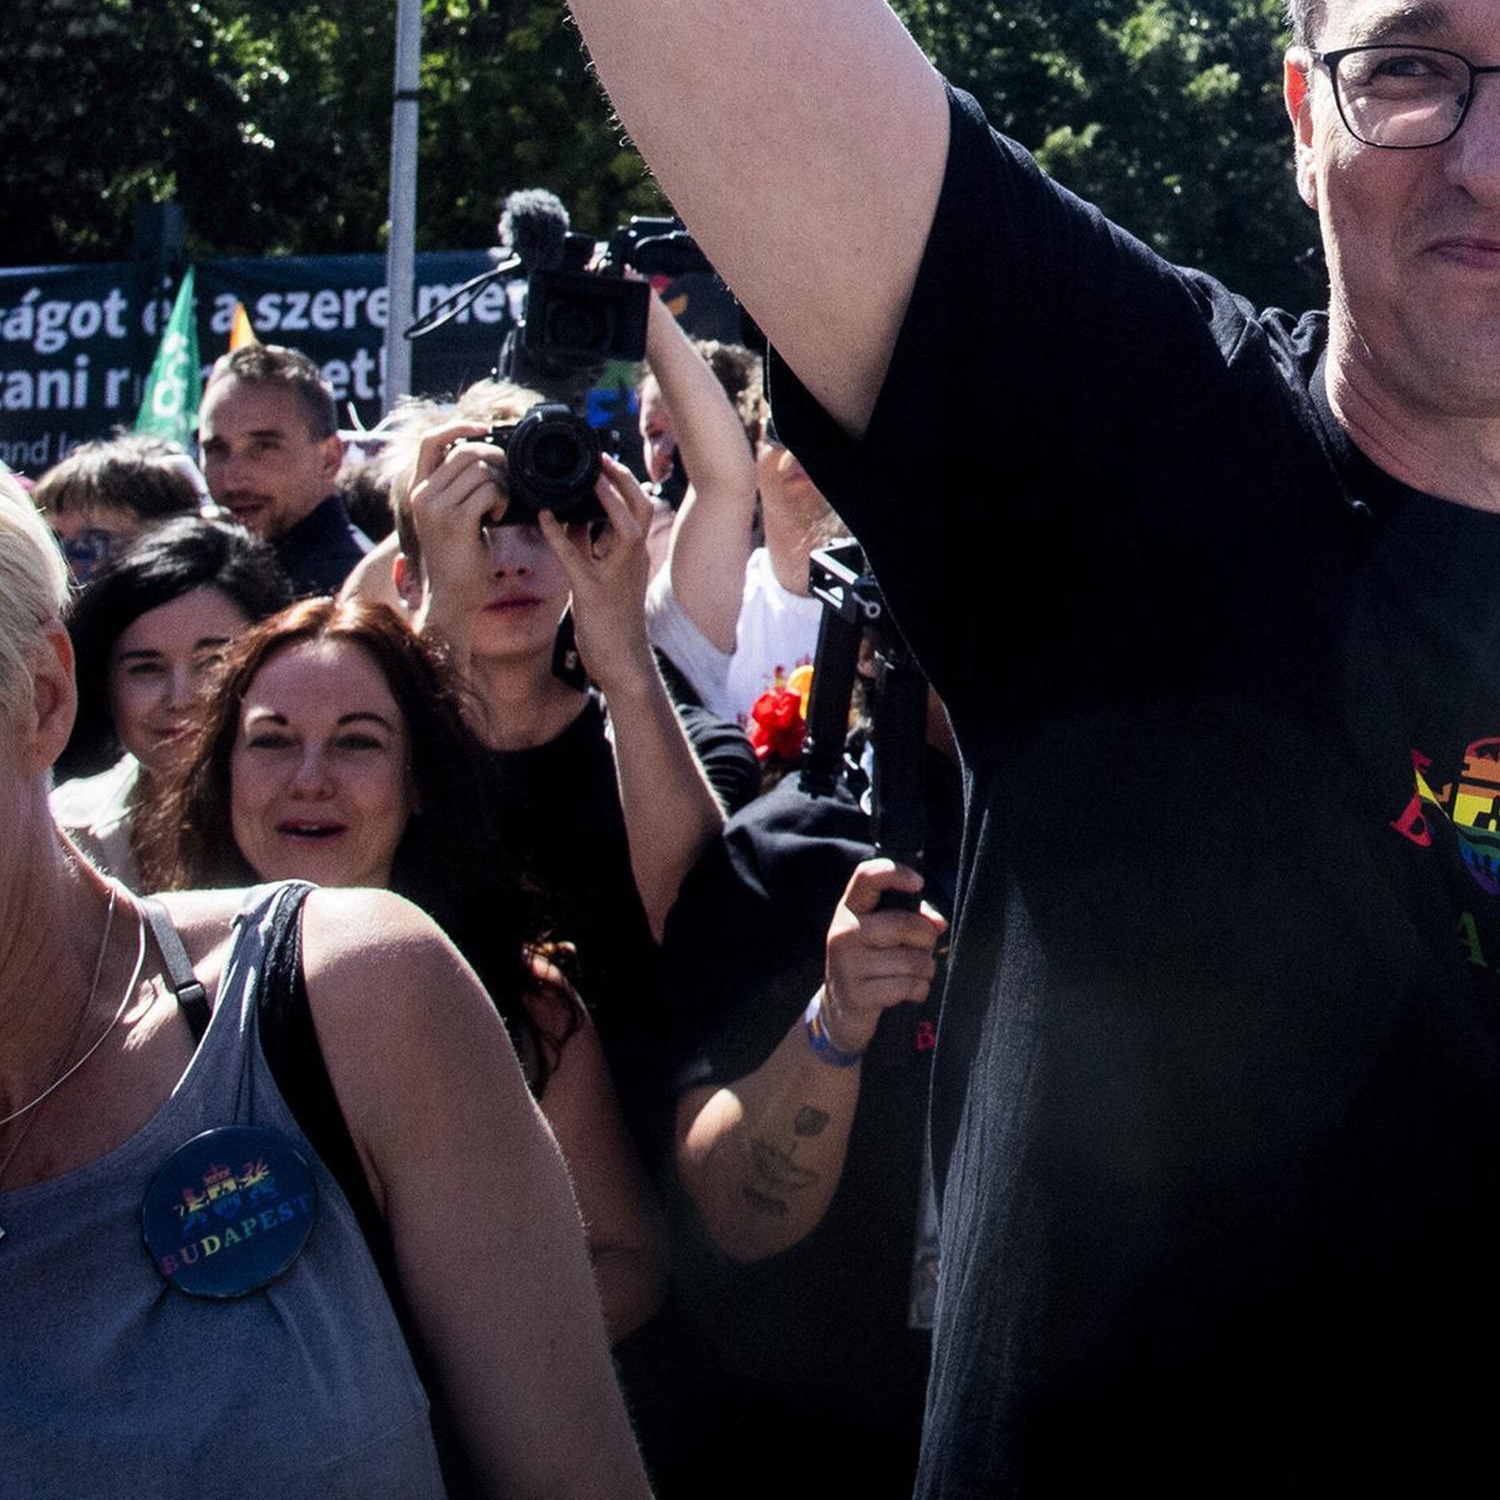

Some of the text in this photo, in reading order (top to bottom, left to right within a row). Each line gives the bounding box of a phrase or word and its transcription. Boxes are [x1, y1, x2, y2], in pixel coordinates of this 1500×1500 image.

[0, 287, 127, 354] ágot
[254, 279, 529, 331] szeremet
[0, 354, 90, 410] ani
